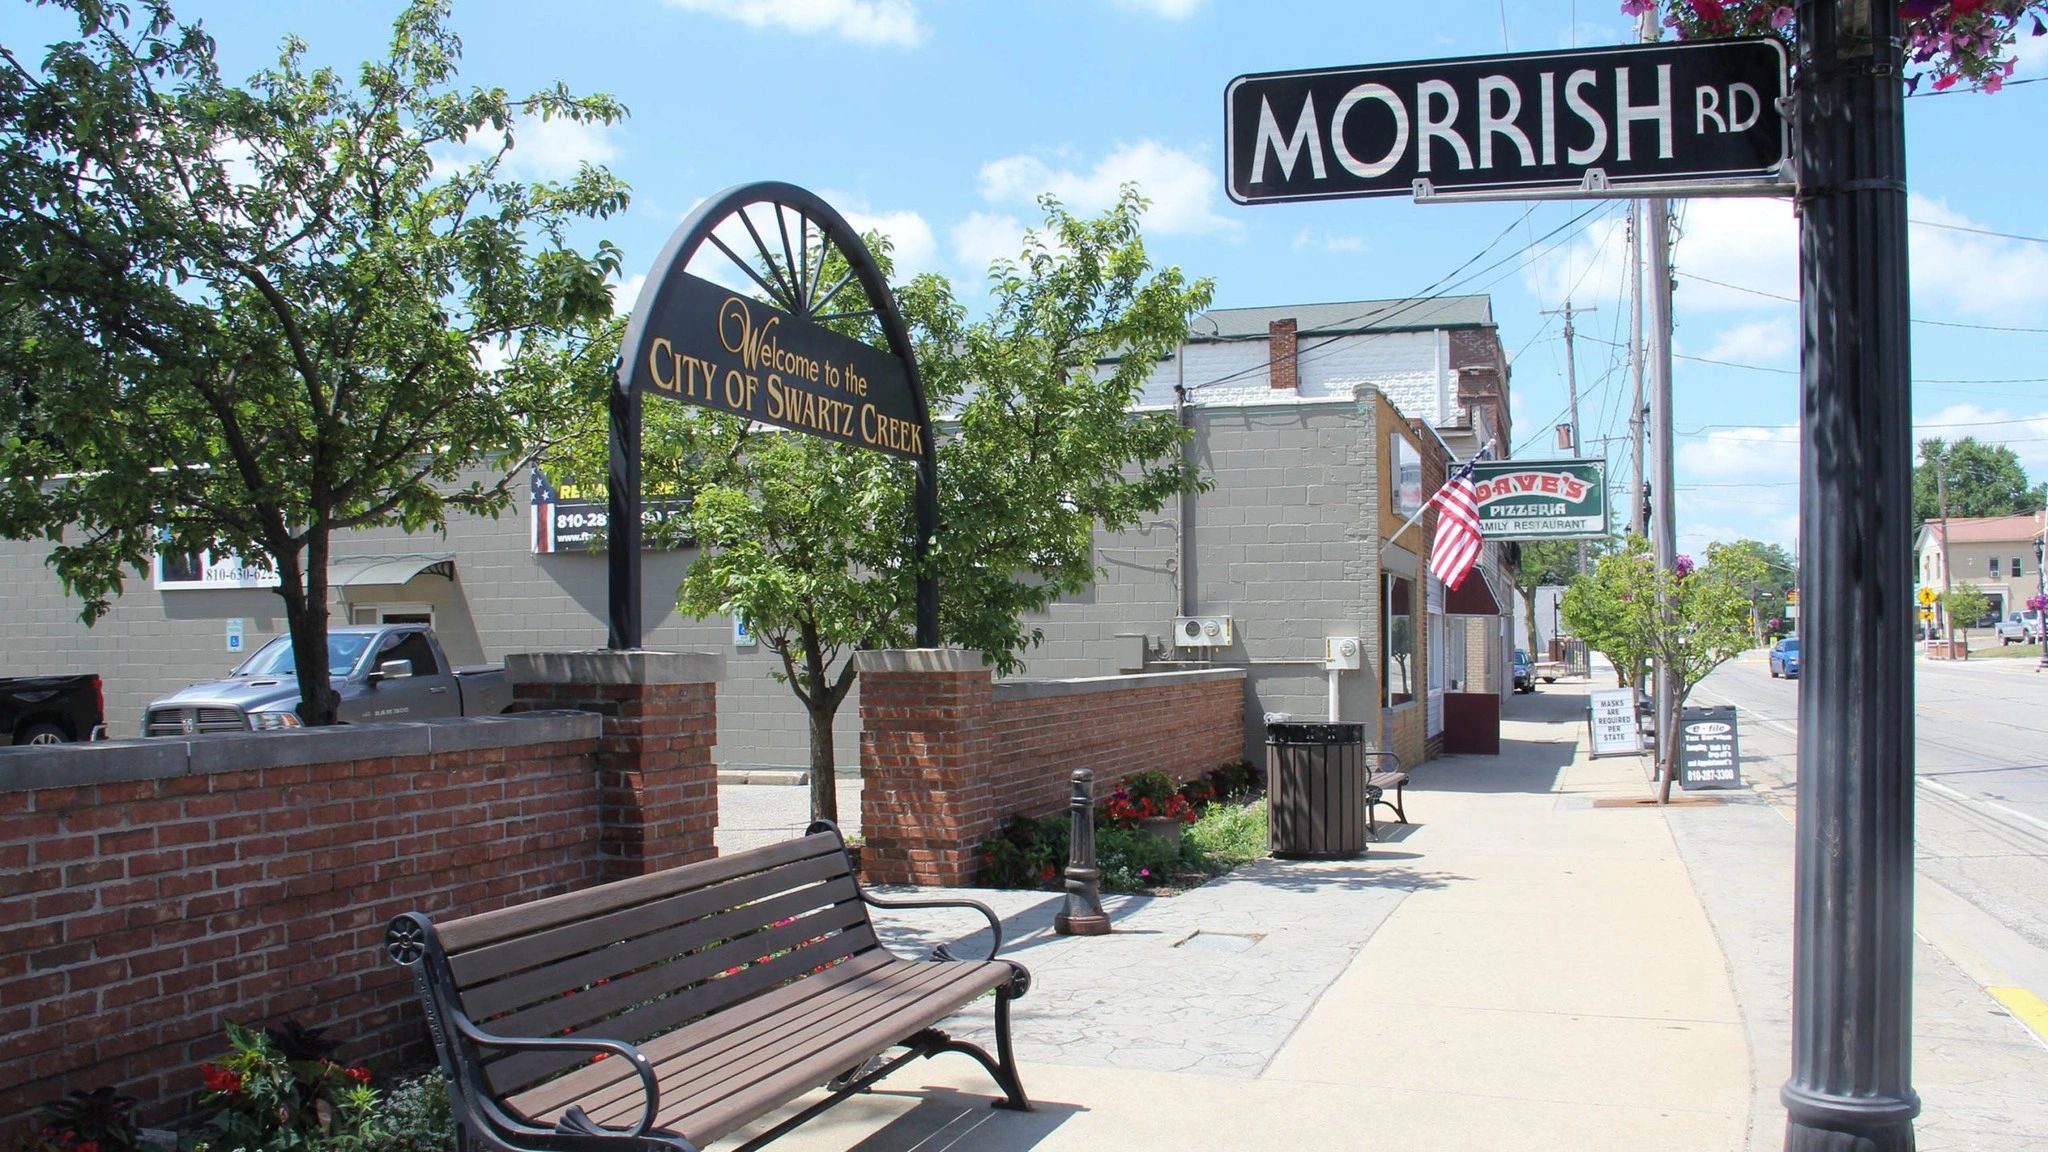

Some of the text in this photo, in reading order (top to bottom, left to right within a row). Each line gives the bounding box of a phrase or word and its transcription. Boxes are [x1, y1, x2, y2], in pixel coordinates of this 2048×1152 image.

[1249, 64, 1761, 184] MORRISH RD
[718, 297, 867, 398] Welcome to the
[650, 337, 923, 454] CITY OF SWARTZ CREEK
[1476, 474, 1585, 502] DAVE'S
[1490, 503, 1567, 517] PIZZERIA
[1479, 519, 1587, 532] AMILY RESTAURANT
[1600, 699, 1625, 708] MASKS
[1607, 708, 1619, 716] ARE
[1598, 716, 1631, 724] REQUIRED
[1604, 733, 1625, 741] STATE
